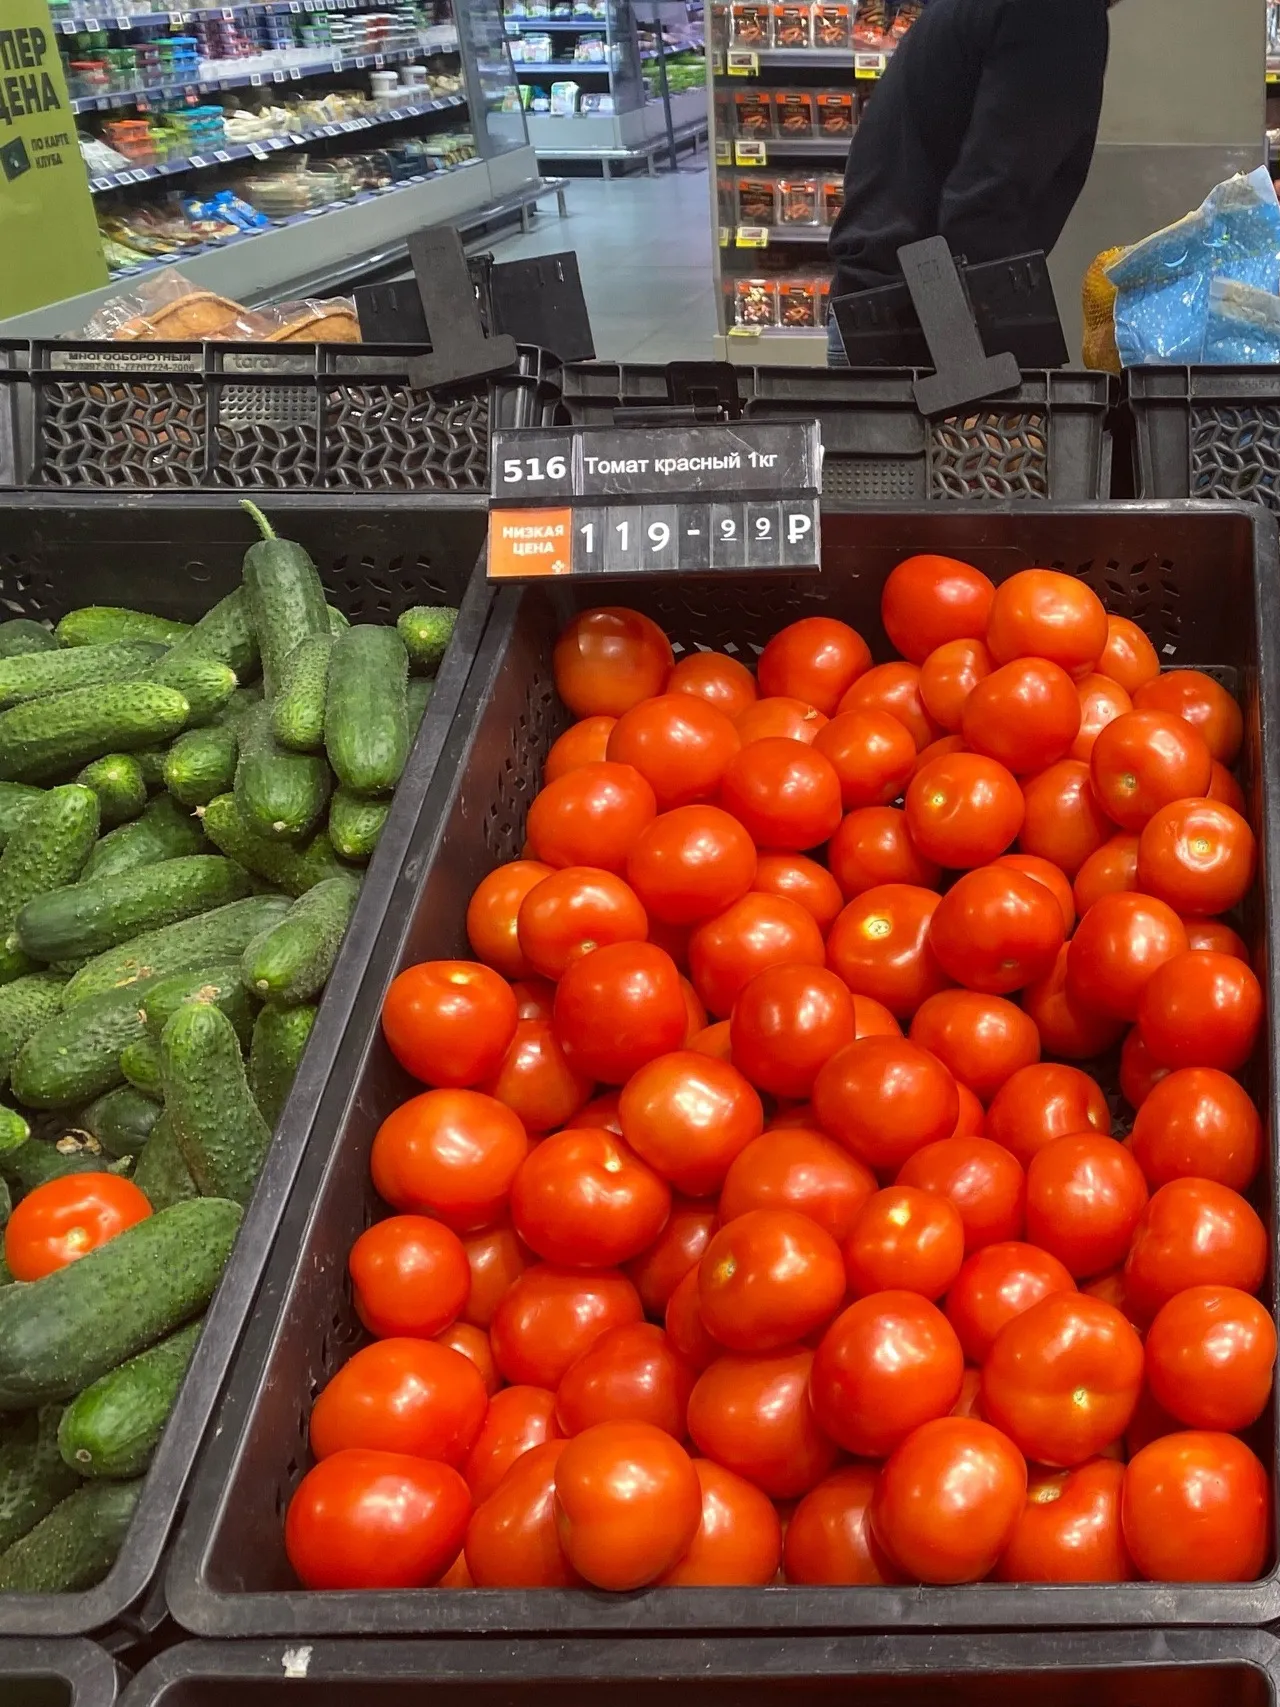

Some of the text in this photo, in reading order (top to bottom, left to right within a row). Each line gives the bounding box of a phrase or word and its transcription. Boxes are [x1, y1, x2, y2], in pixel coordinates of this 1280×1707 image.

[31, 133, 70, 151] ПО КАРТЕ
[36, 153, 63, 169] КЛУБА
[503, 456, 567, 482] 516
[584, 451, 778, 475] Томат красный 1кг
[502, 524, 565, 539] НИЗКАЯ
[512, 542, 554, 556] ЦЕНА
